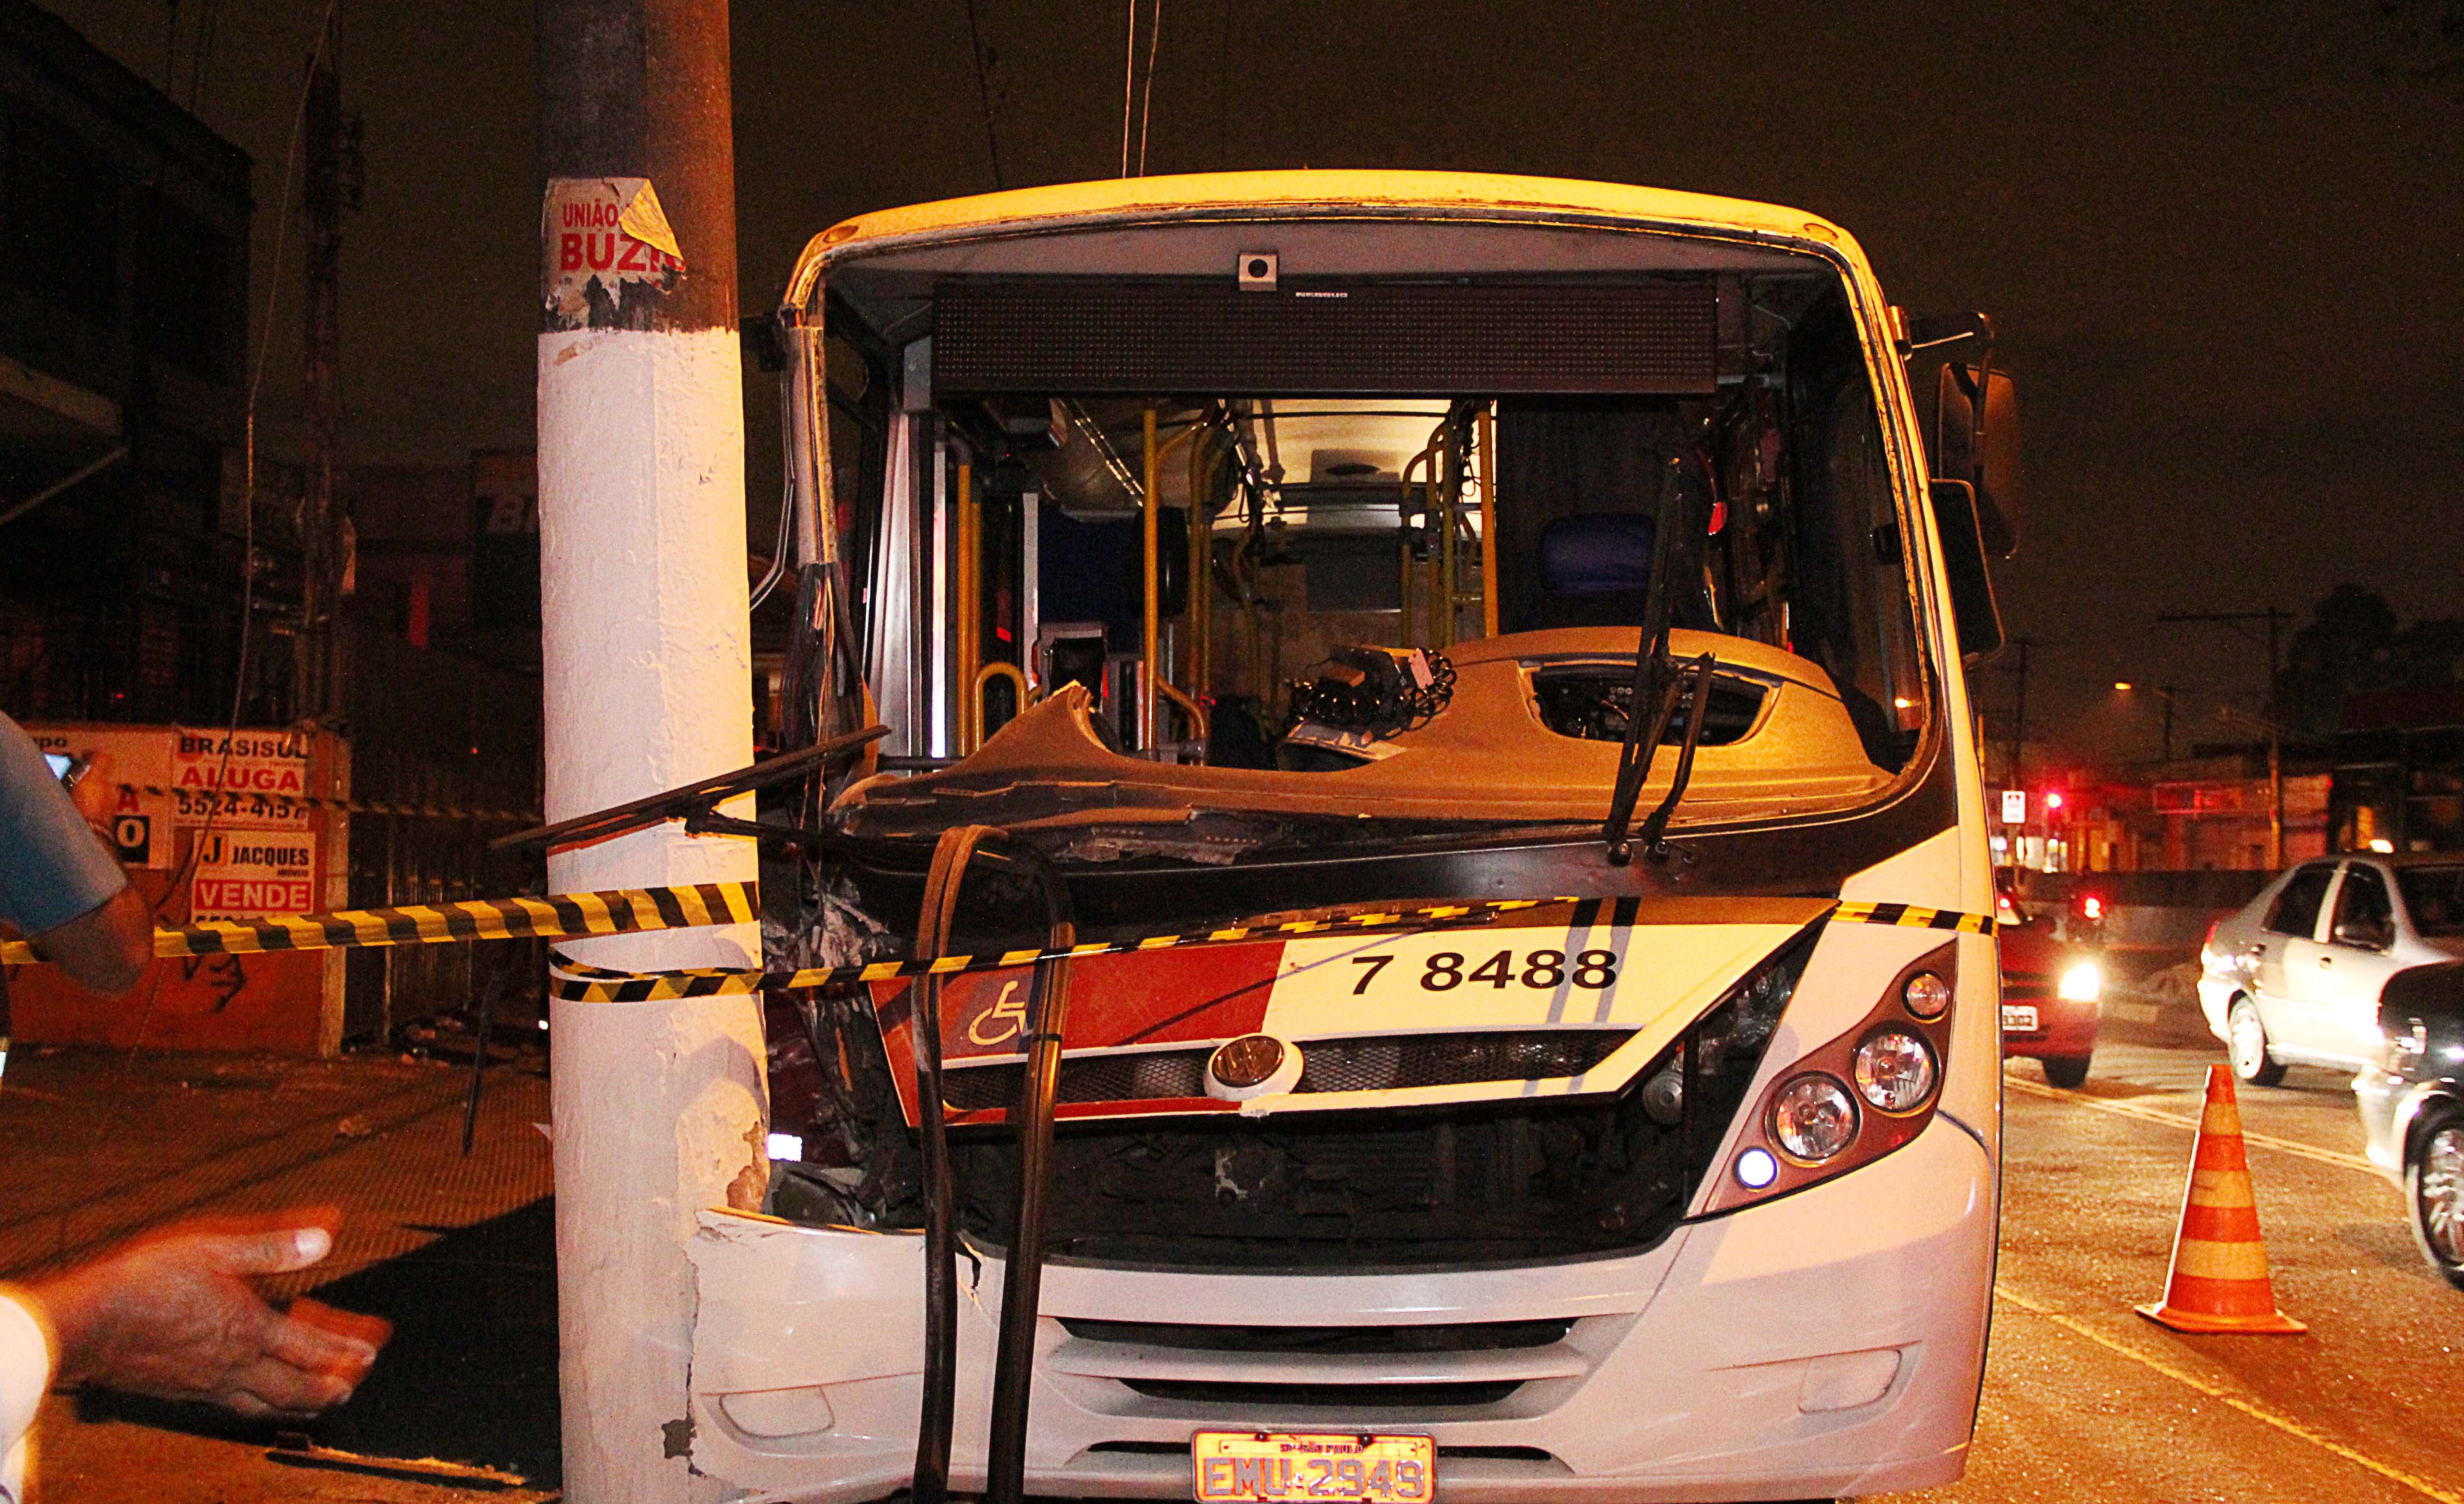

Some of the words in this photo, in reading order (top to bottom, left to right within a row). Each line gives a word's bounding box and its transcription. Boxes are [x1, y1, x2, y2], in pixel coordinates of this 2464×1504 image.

[563, 199, 618, 227] UNIÃO
[181, 736, 308, 759] BRASISUL
[181, 766, 300, 791] ALUGA
[233, 846, 309, 867] JACQUES
[200, 883, 308, 909] VENDE
[1352, 955, 1394, 995] 7
[1420, 949, 1617, 991] 8488
